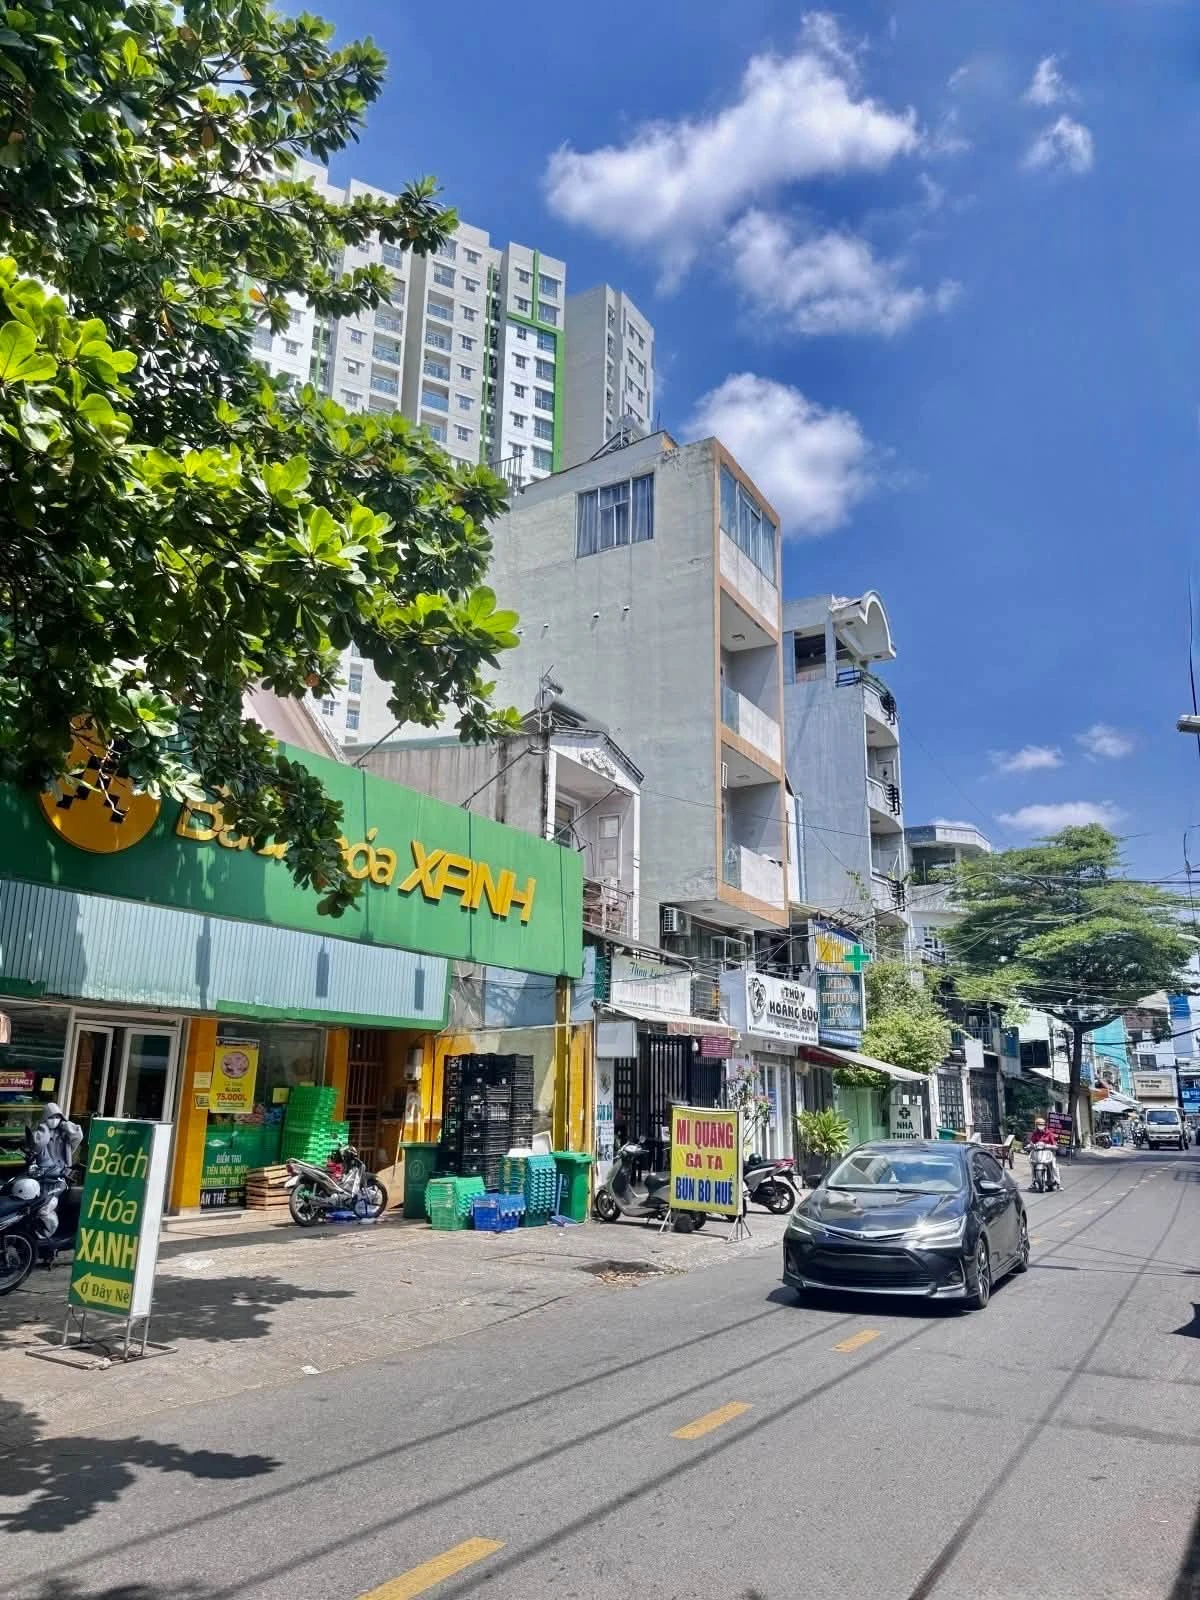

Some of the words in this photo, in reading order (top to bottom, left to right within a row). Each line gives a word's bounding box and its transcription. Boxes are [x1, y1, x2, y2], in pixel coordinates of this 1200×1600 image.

[398, 839, 537, 923] XANH
[800, 991, 806, 1002] Y
[89, 1144, 149, 1179] Bách
[706, 1154, 723, 1171] TA
[88, 1188, 138, 1225] Hóa
[76, 1228, 139, 1272] XANH
